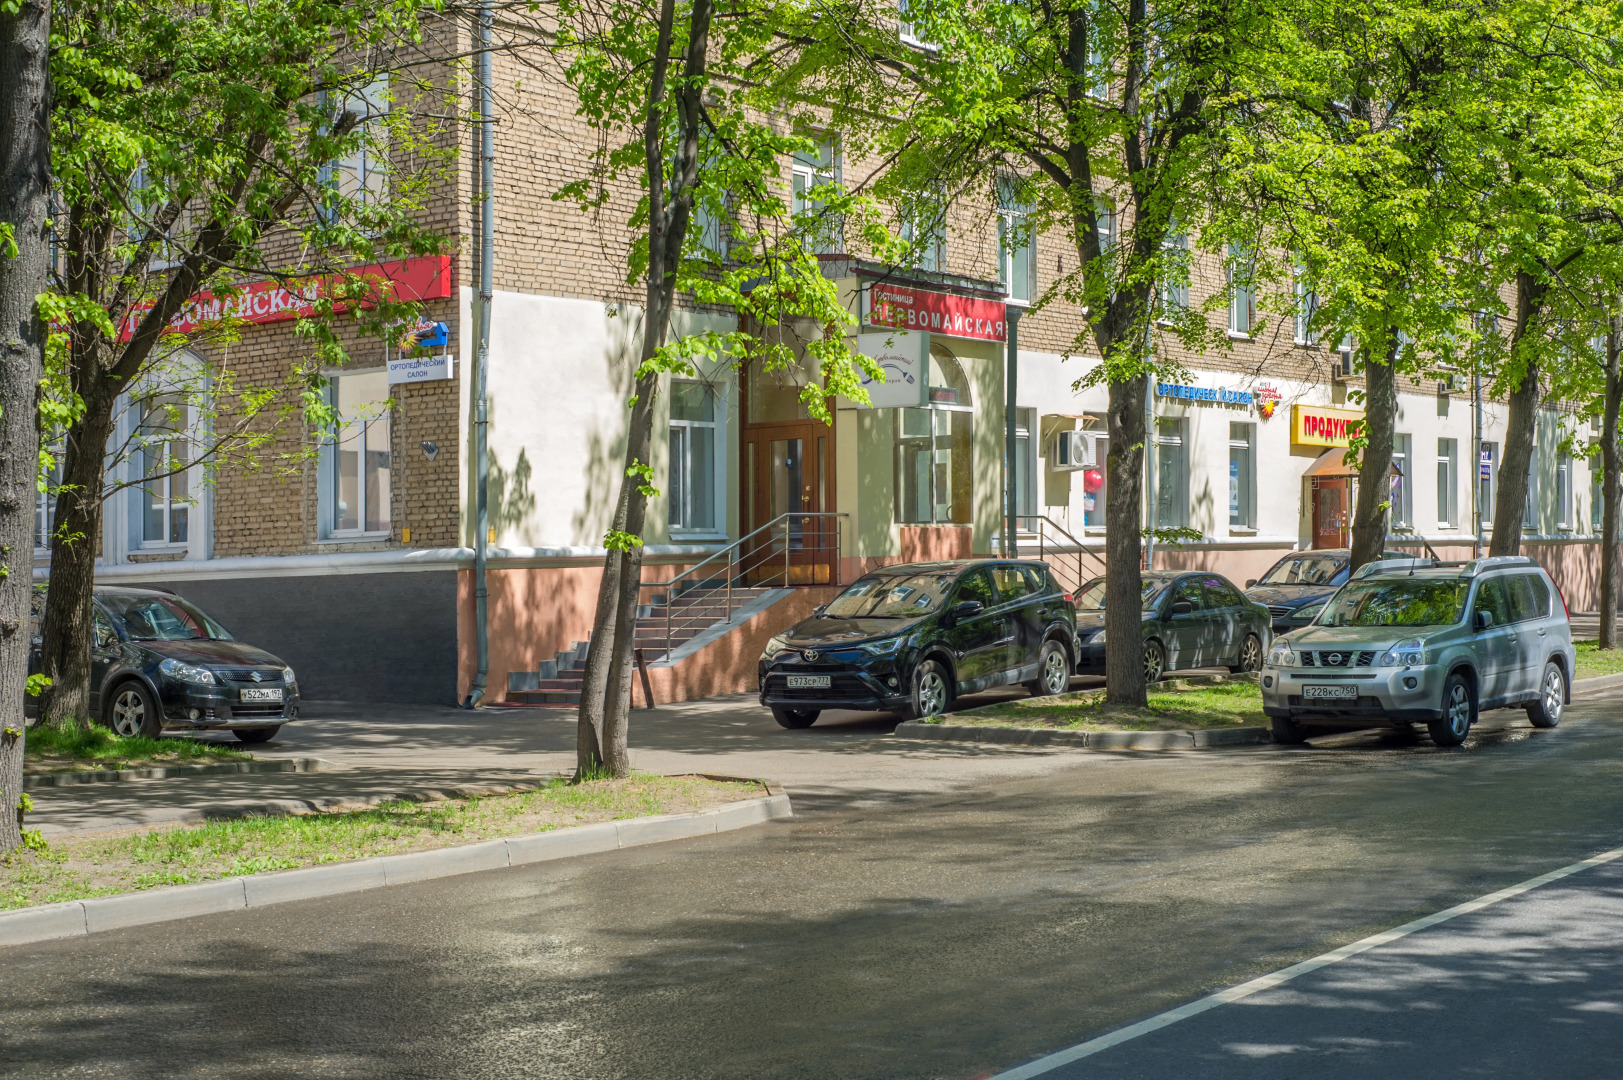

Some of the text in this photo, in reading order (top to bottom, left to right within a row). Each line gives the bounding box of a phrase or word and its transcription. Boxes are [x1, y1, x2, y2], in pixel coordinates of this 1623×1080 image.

[874, 288, 913, 305] Гостиница
[874, 304, 1003, 337] ПЕРВОМАЙСКАЯ
[390, 358, 446, 371] ОРТОПЕДИЧЕСКИЙ
[407, 370, 428, 379] САЛОН
[1228, 390, 1253, 405] САЛОН
